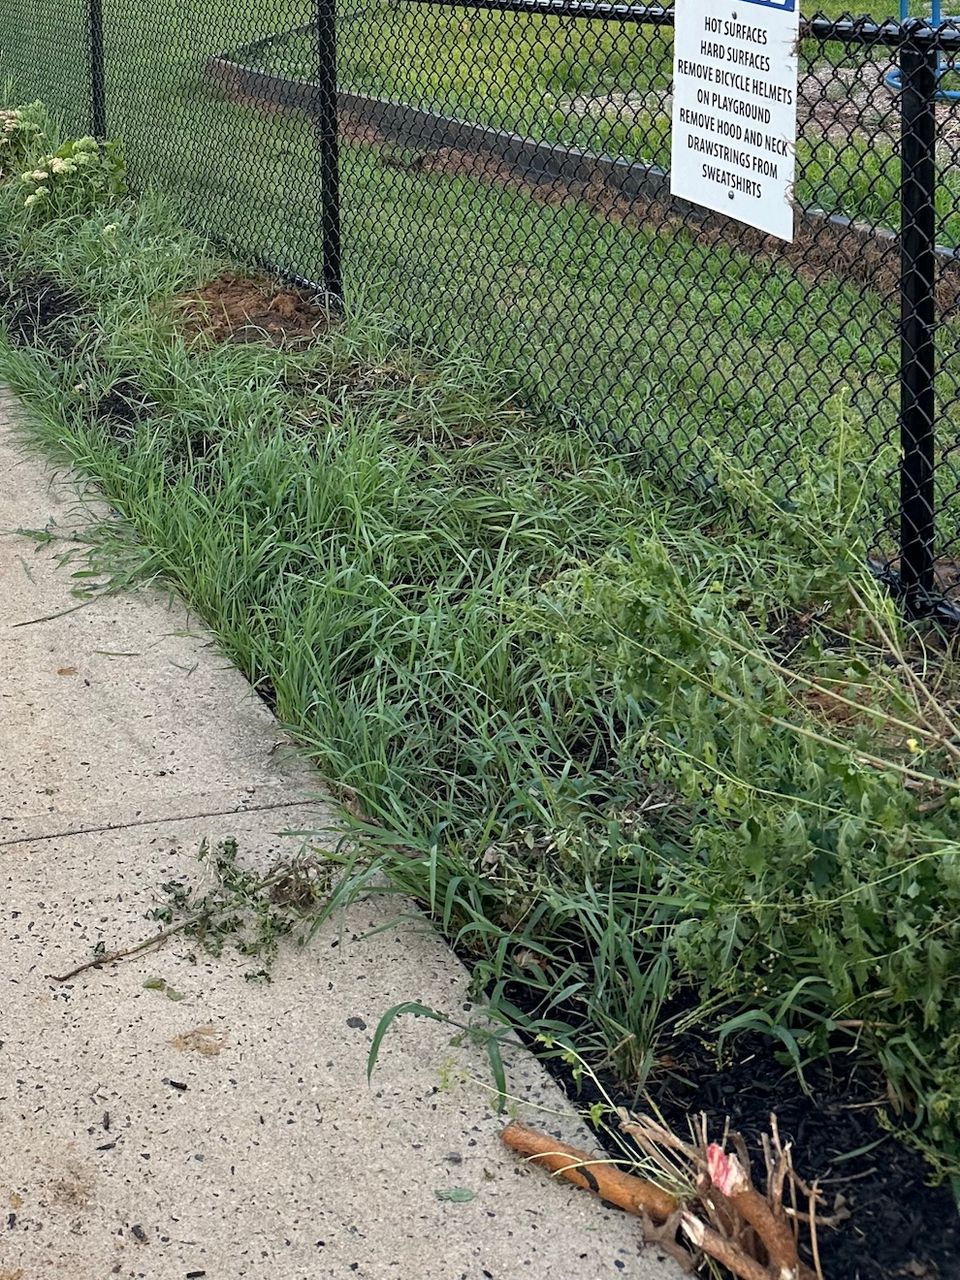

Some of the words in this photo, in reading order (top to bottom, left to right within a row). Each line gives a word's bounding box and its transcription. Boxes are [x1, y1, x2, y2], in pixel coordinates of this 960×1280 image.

[704, 16, 723, 34] HOT
[724, 21, 767, 45] SURFACES
[700, 40, 725, 59] HARD
[727, 47, 770, 72] SURFACES
[678, 59, 713, 82] REMOVE
[715, 69, 750, 92] BICYCLE
[752, 79, 792, 105] HELMETS
[697, 89, 710, 105] ON
[712, 92, 770, 124] PLAYGROUND
[680, 108, 715, 132] REMOVE
[717, 119, 742, 140] HOOD
[744, 128, 763, 147] AND
[765, 135, 788, 157] NECK
[688, 134, 750, 168] DRAWSTRINGS
[752, 156, 778, 179] FROM
[702, 164, 762, 198] SWEATSHIRTS
